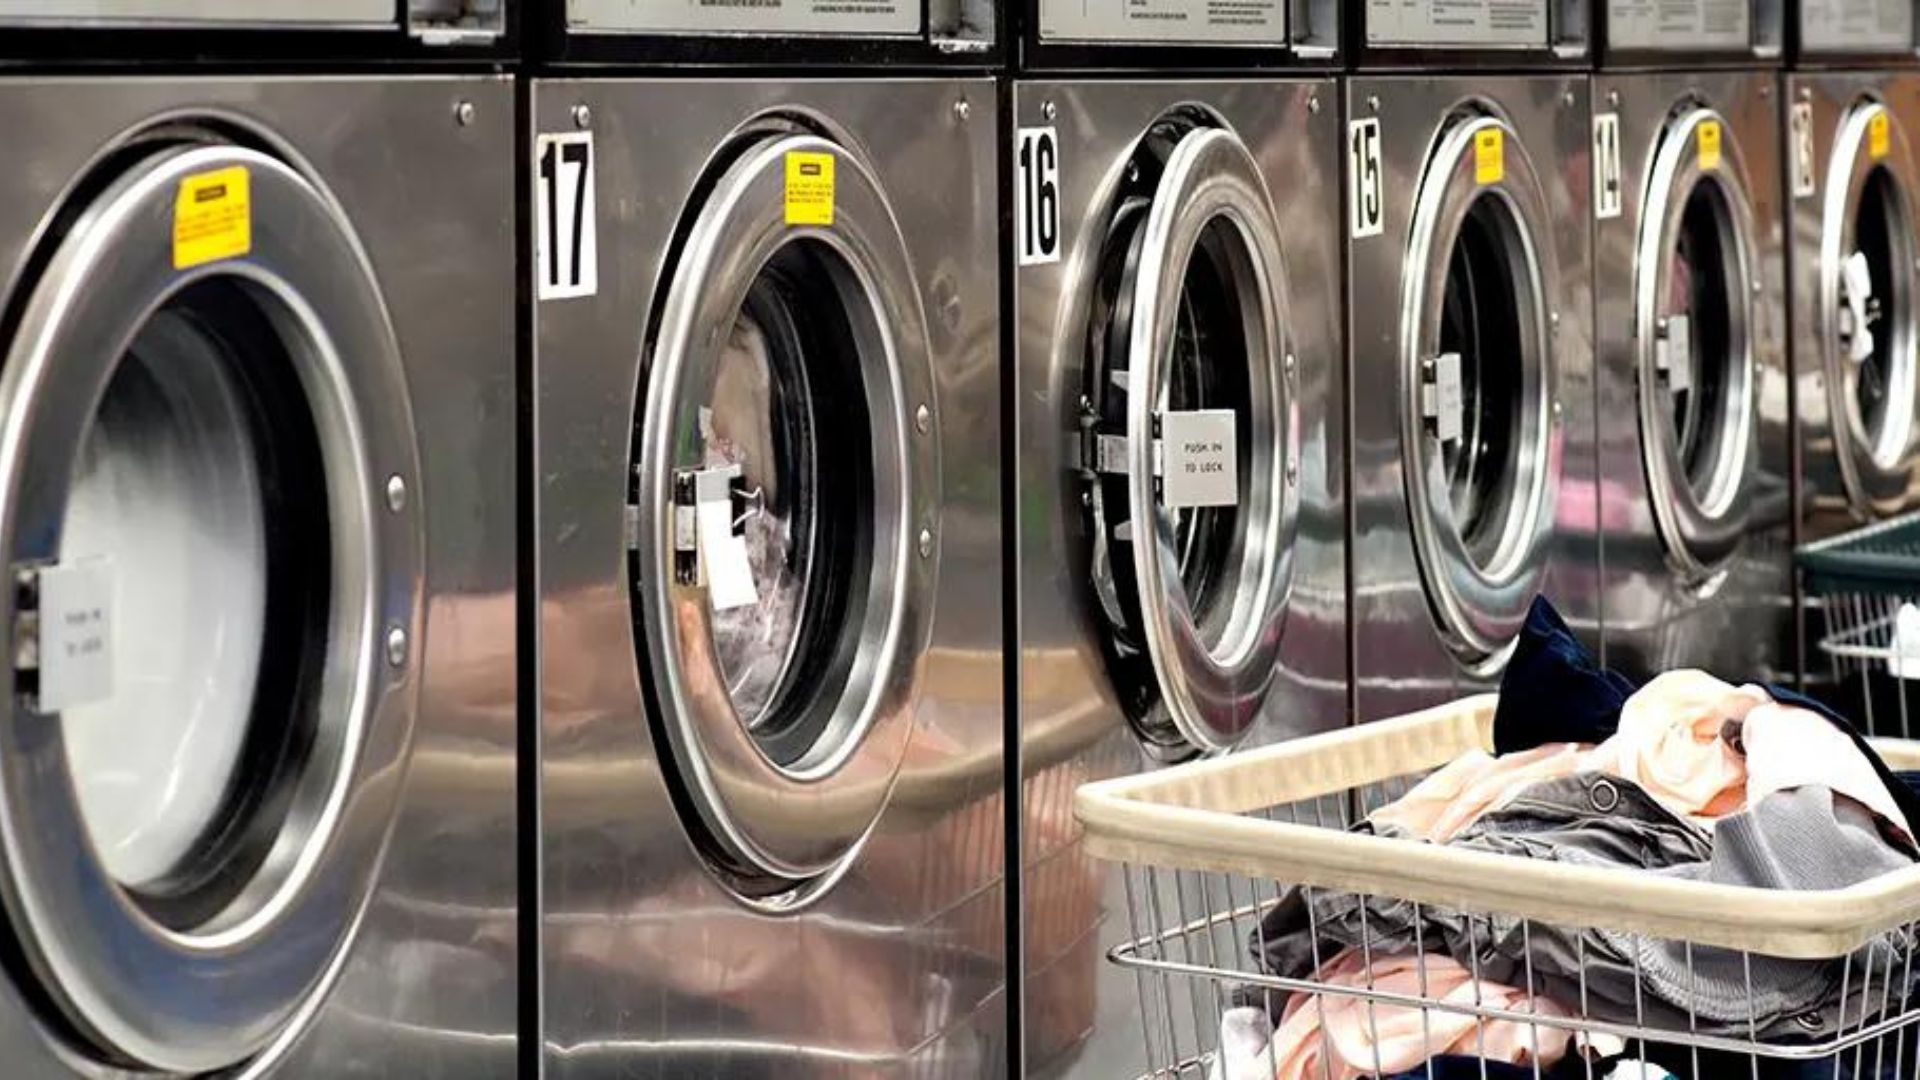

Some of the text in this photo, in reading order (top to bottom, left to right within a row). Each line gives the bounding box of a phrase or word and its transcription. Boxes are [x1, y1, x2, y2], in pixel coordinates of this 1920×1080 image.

[540, 141, 588, 286] 17
[1021, 132, 1057, 256] 16
[1352, 124, 1379, 229] 15
[1596, 120, 1618, 211] 14
[1185, 443, 1208, 454] PUSH
[1185, 462, 1223, 473] TO LOCK
